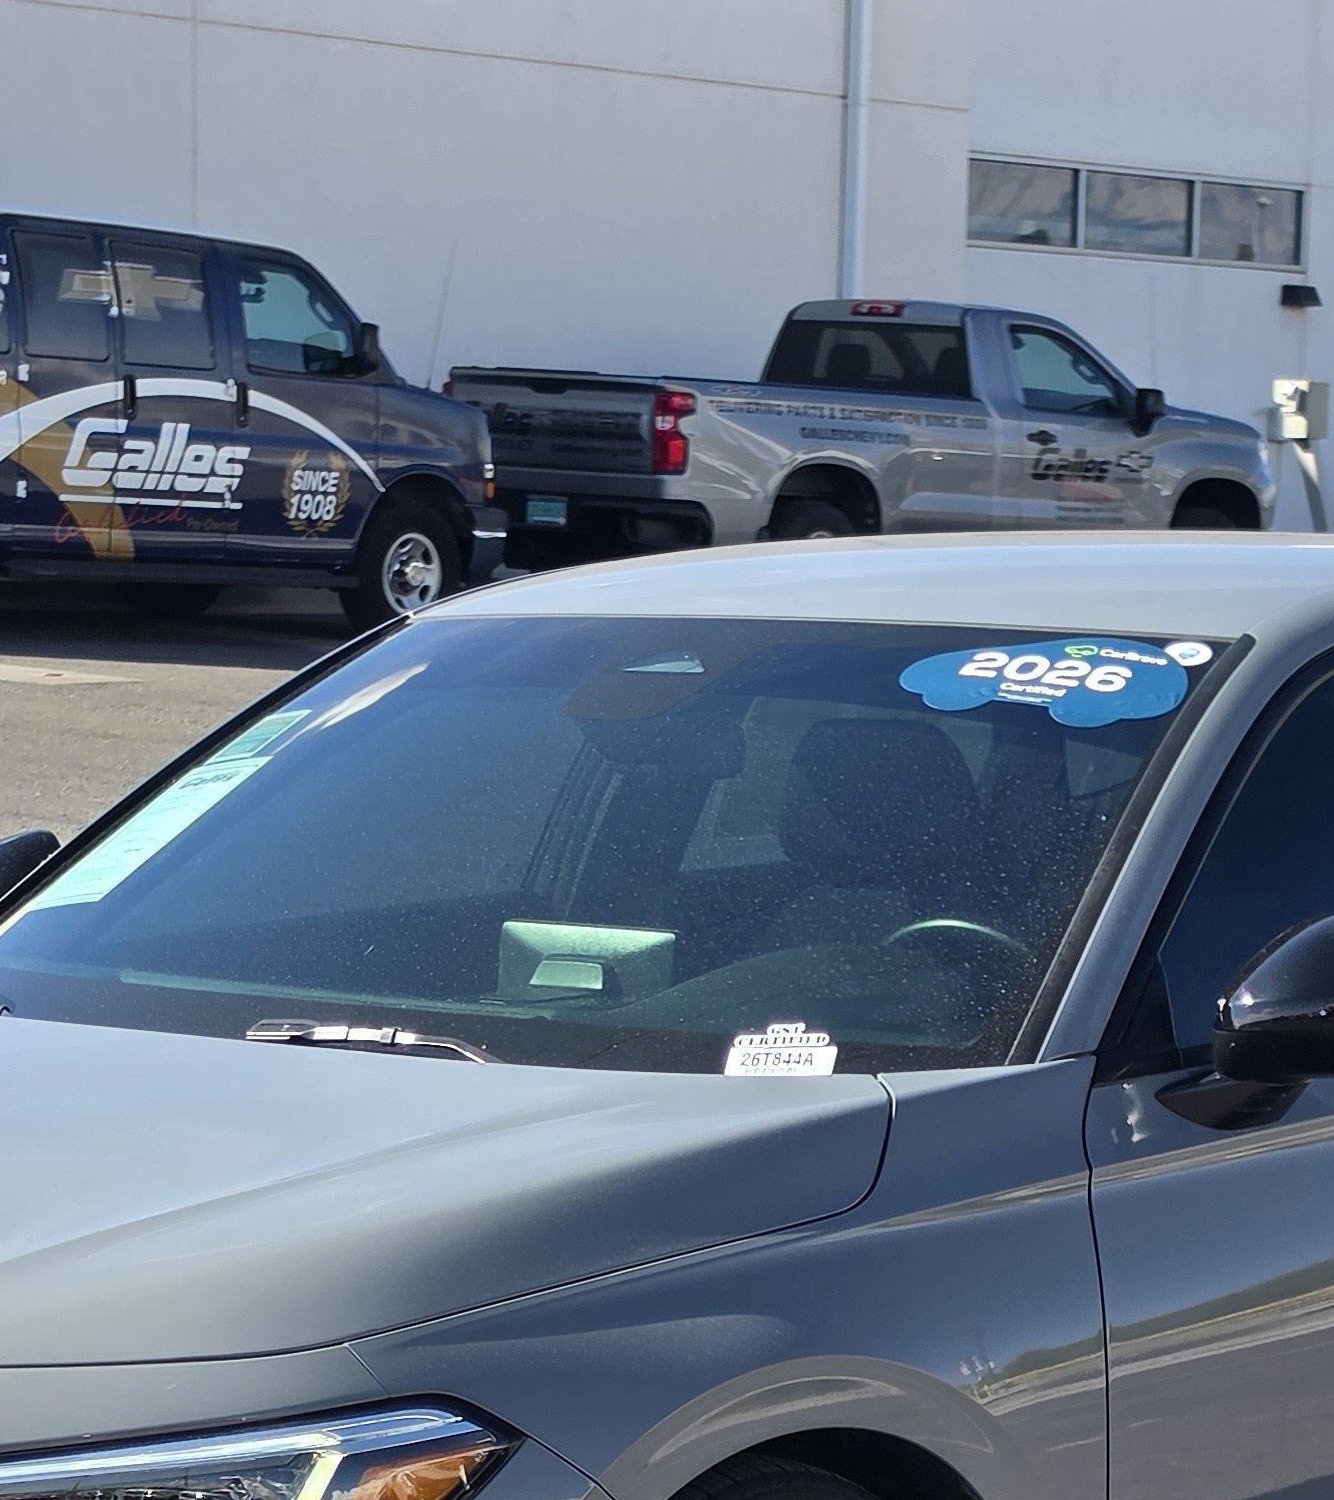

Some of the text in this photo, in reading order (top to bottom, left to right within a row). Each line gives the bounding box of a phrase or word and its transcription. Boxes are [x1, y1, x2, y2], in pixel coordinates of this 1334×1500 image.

[61, 417, 251, 494] Galles
[290, 470, 340, 492] SINCE
[287, 493, 338, 520] 1908
[958, 651, 1133, 692] 2026
[999, 682, 1067, 697] Certified
